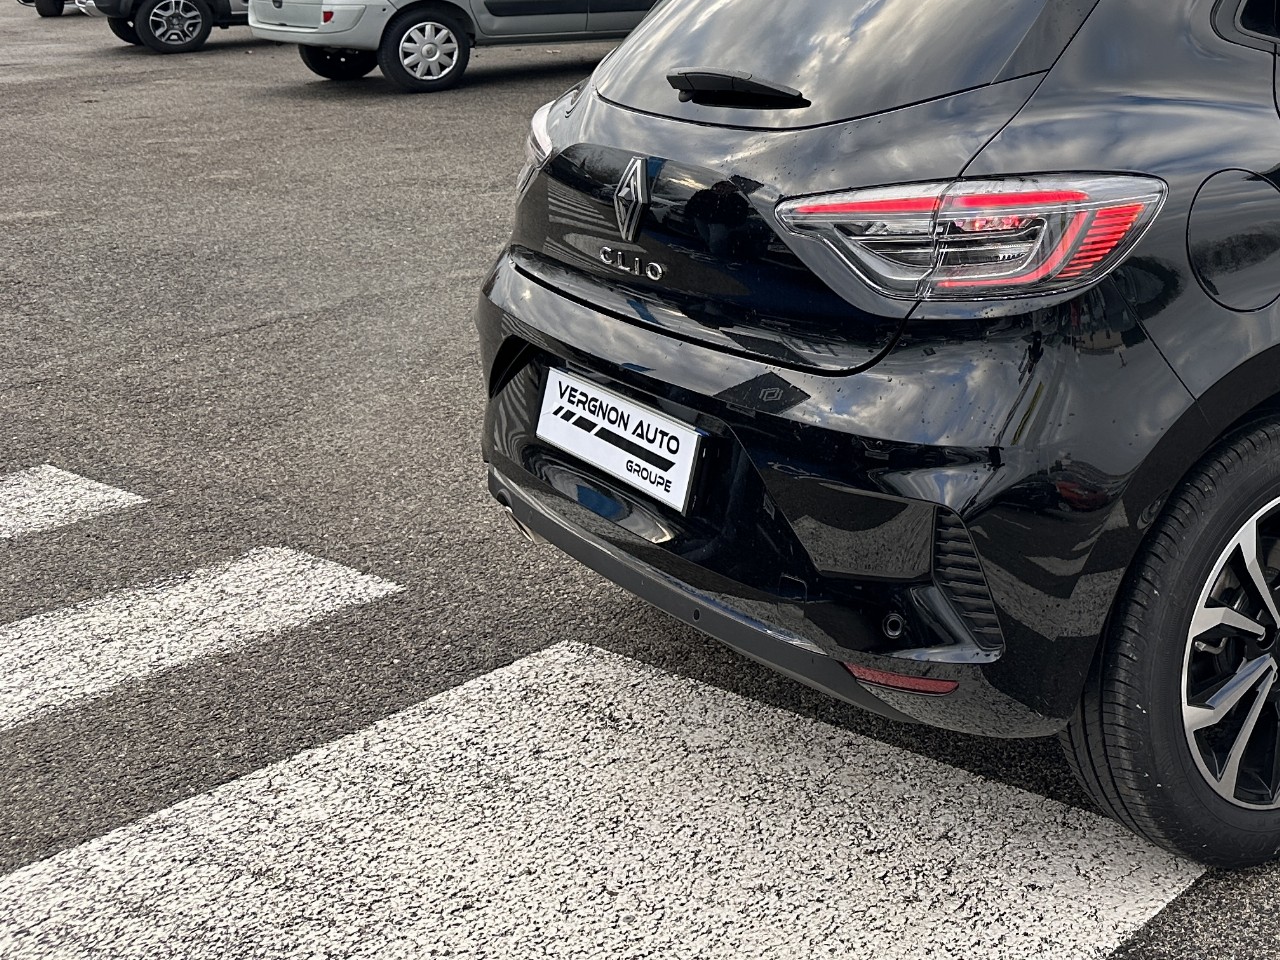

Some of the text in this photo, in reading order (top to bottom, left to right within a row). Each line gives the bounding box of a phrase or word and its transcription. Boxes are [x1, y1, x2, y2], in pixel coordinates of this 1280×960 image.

[600, 246, 664, 282] CLIO
[558, 381, 681, 455] VERGNON AUTO
[626, 460, 673, 493] GROUPE
